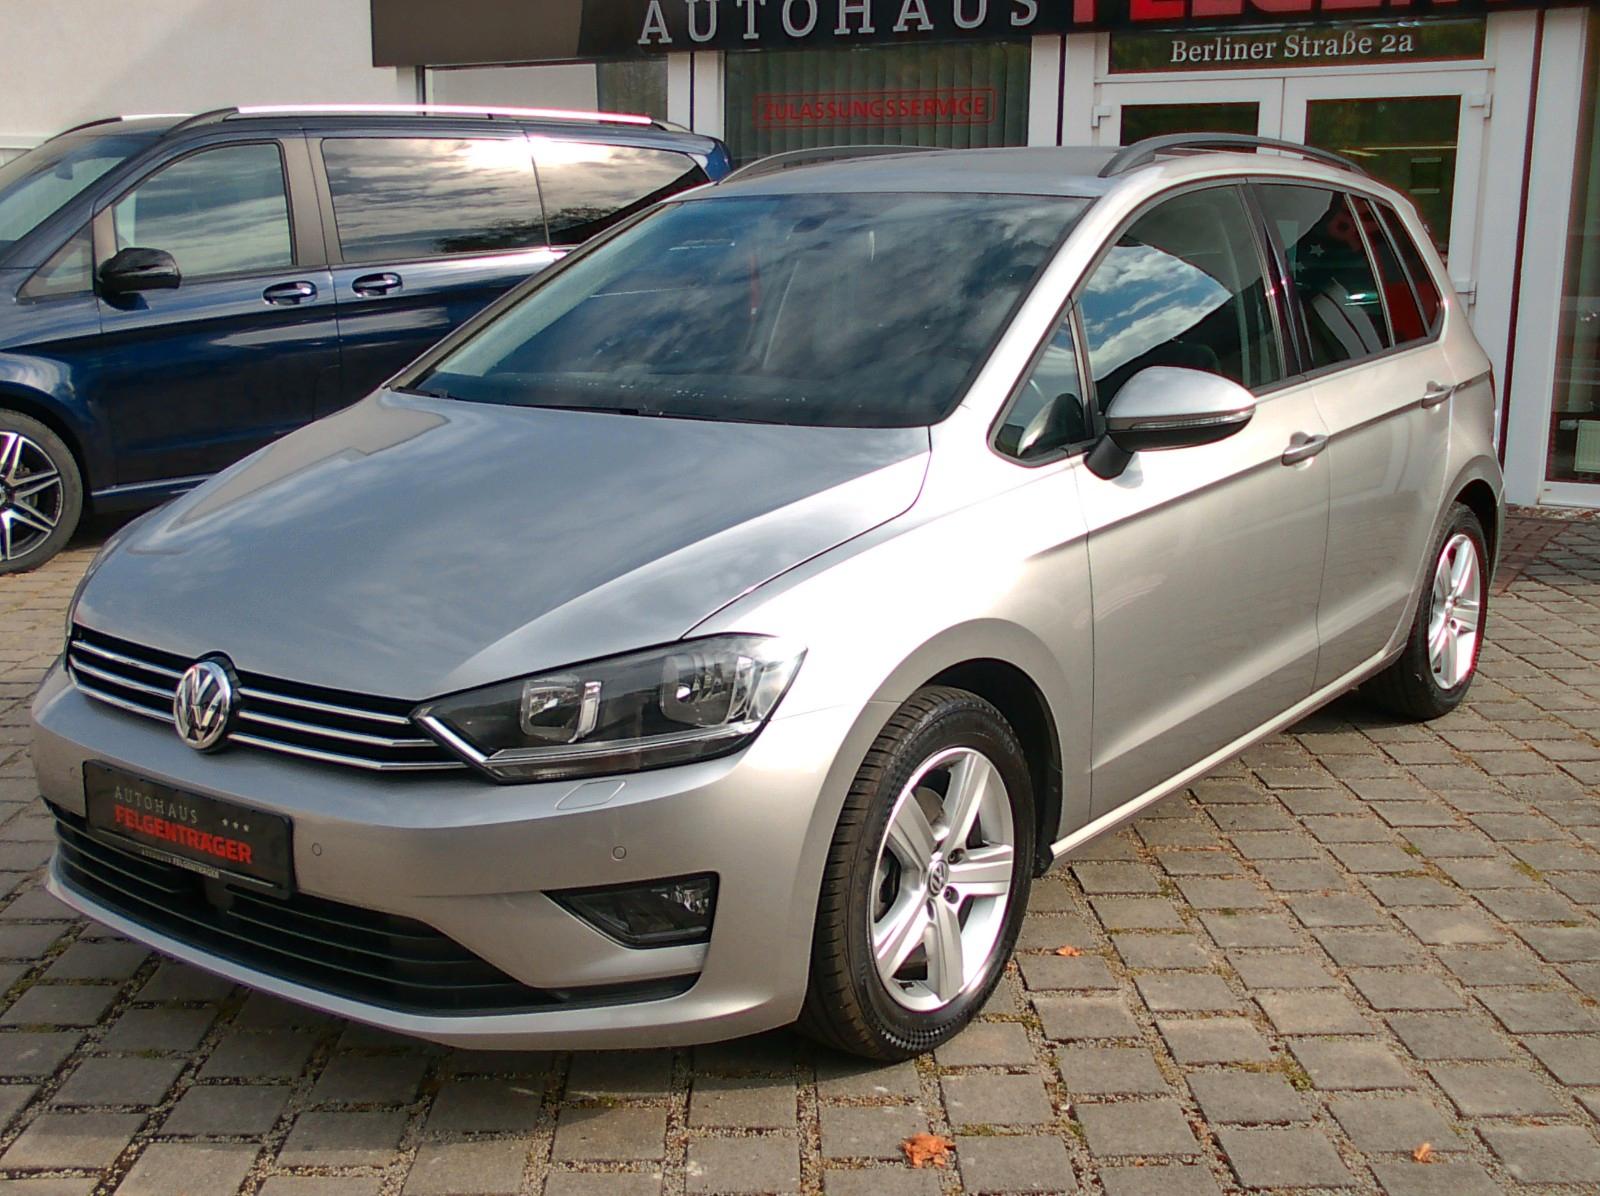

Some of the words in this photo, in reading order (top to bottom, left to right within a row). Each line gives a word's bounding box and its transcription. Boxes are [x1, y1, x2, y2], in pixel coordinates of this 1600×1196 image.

[637, 0, 1038, 44] AUTOHAUS
[1170, 37, 1277, 62] Berliner
[1283, 31, 1373, 58] Straße
[1380, 34, 1414, 53] 2a
[763, 97, 986, 121] ZULASSUNGSSERVICE
[114, 785, 199, 824] AUTOHAUS
